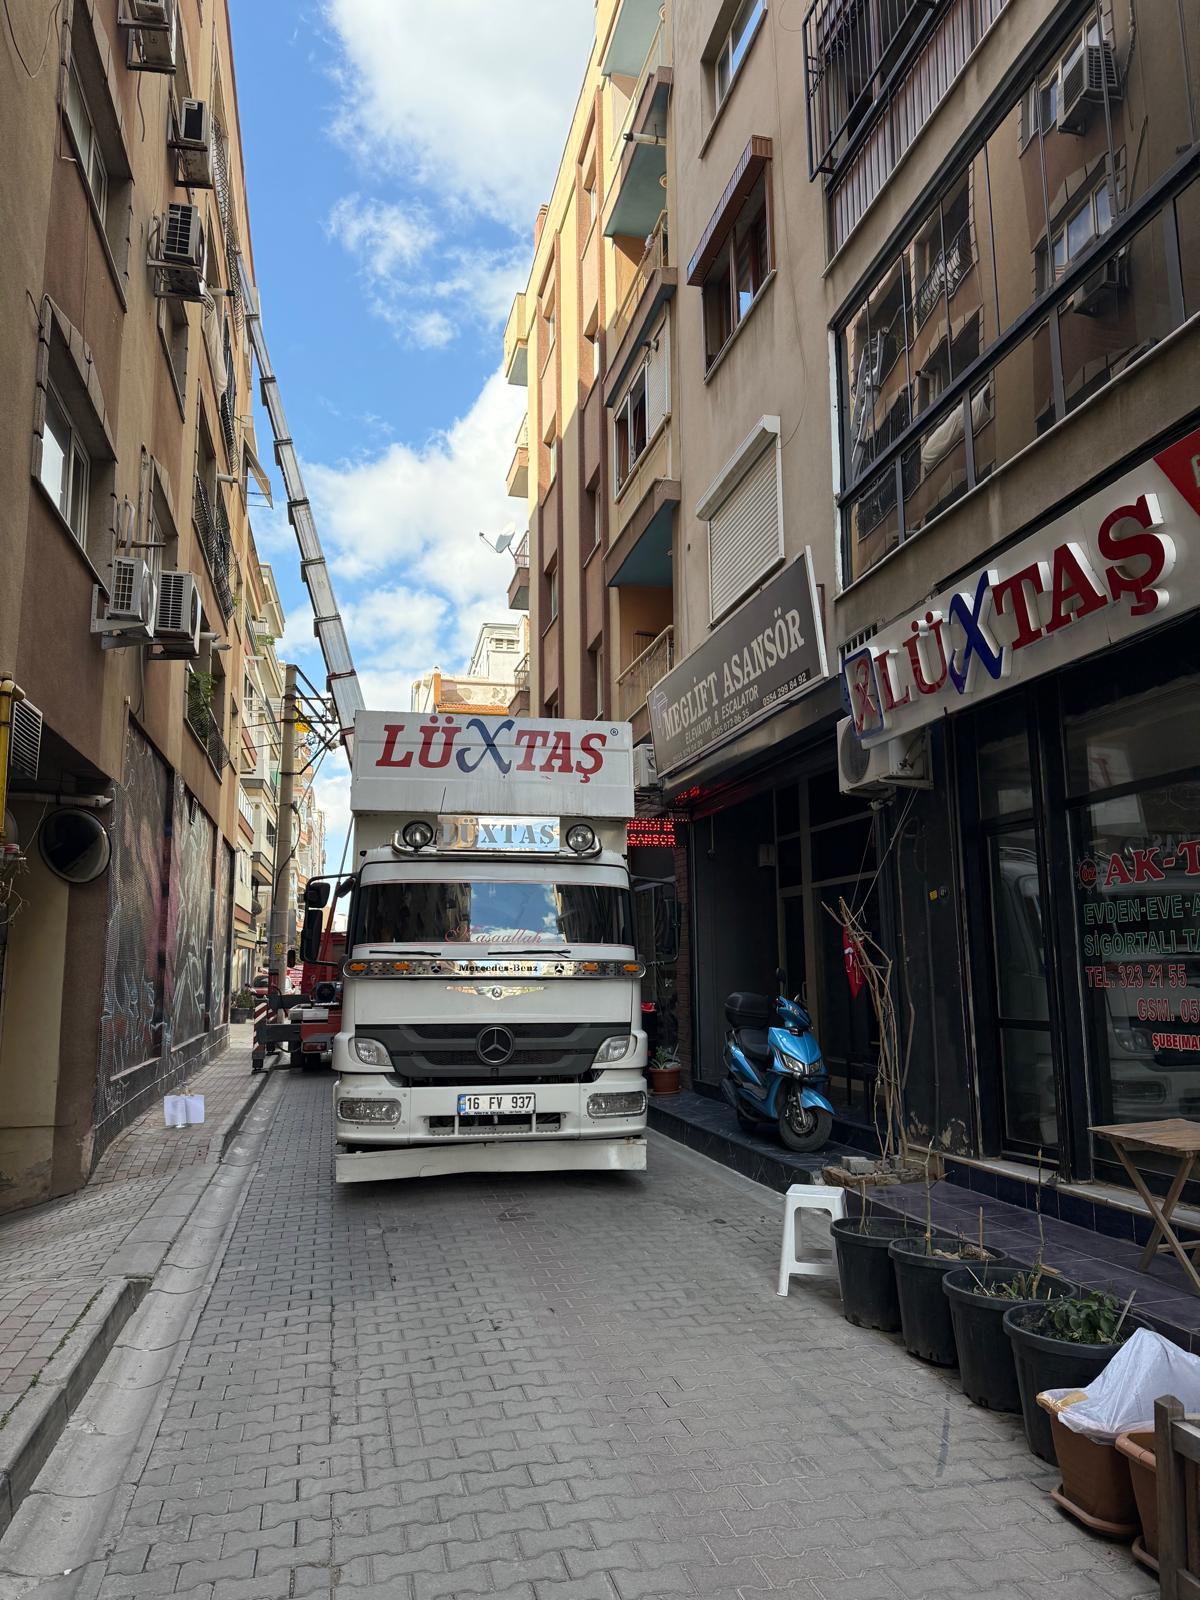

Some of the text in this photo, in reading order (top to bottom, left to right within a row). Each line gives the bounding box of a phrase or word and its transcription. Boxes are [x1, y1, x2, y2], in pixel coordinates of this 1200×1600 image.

[874, 494, 1176, 712] LÜXTAŞ
[663, 606, 805, 741] MEGLİFT ASANSÖR
[762, 691, 777, 706] 0554
[798, 672, 807, 684] 92
[685, 717, 712, 744] ELEVATOR
[722, 684, 759, 720] ESCALATOR
[375, 715, 607, 783] LÜXTAŞ
[1084, 929, 1177, 957] SİGORTALI
[458, 963, 538, 973] Mercedes-Benz
[1119, 964, 1144, 988] 323
[1147, 964, 1164, 988] 21
[1168, 963, 1188, 988] 55
[467, 1095, 532, 1110] 16 FV 937
